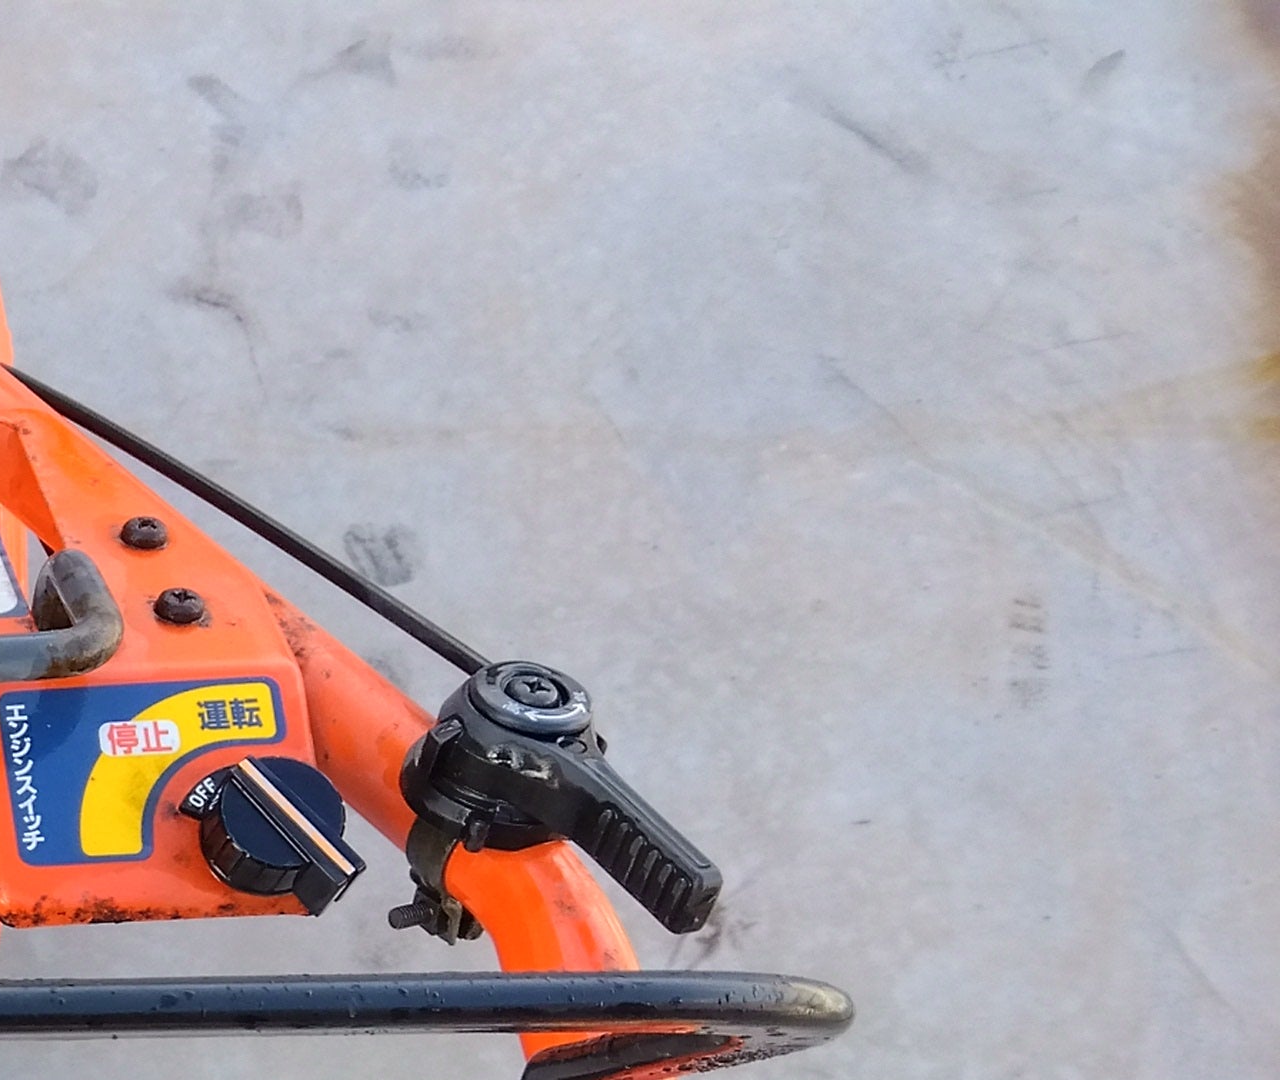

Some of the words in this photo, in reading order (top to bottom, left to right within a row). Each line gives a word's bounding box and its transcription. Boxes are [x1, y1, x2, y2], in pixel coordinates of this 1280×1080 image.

[197, 697, 263, 732] 運転
[105, 722, 174, 756] 停止
[4, 703, 46, 852] エンジンスイッチ
[189, 776, 215, 807] OFF
